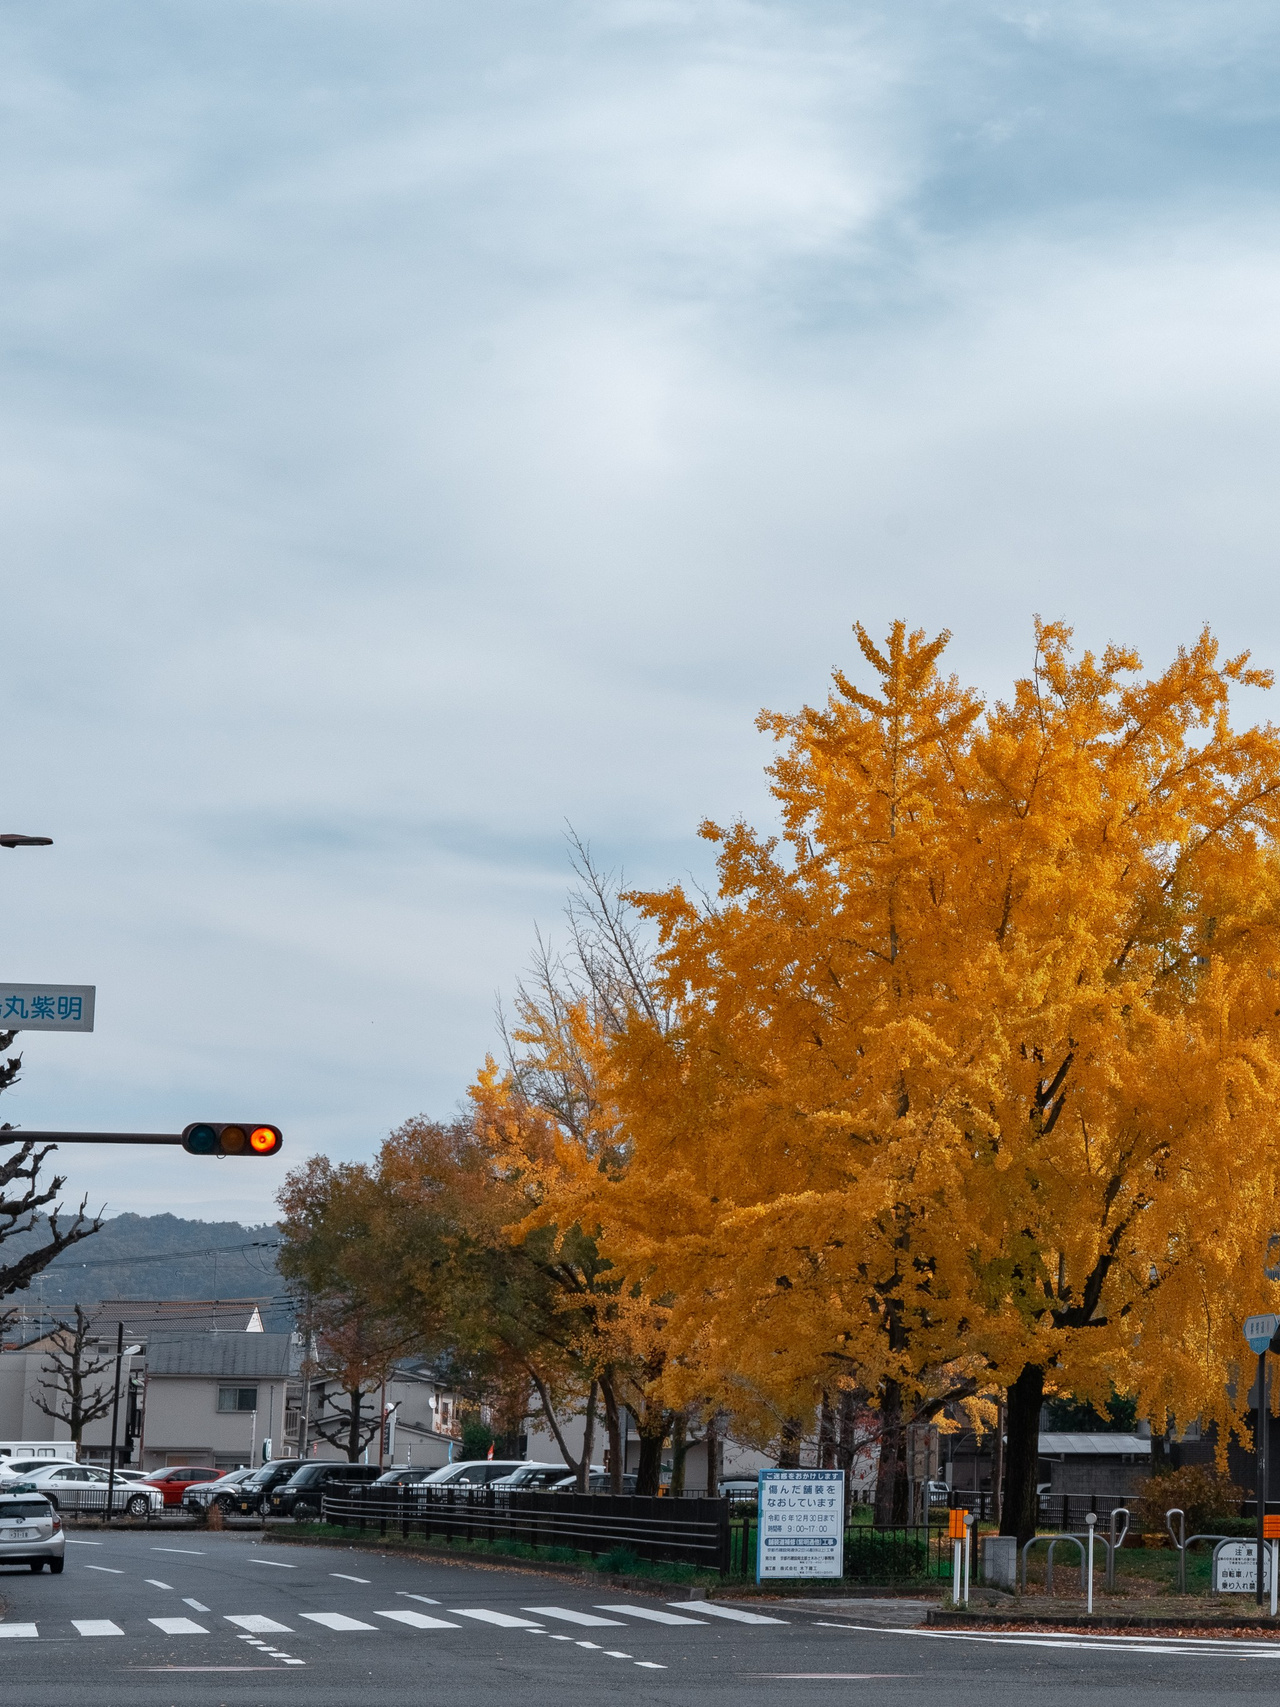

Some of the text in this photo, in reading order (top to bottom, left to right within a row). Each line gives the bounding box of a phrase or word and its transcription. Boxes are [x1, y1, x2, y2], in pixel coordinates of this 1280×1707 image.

[766, 1472, 839, 1480] ご迷惑をおかけします
[768, 1484, 836, 1495] 傷んだ舗装を
[767, 1498, 837, 1508] なおしています
[1235, 1548, 1253, 1556] 注意
[1222, 1582, 1265, 1590] 乗り入れ禁
